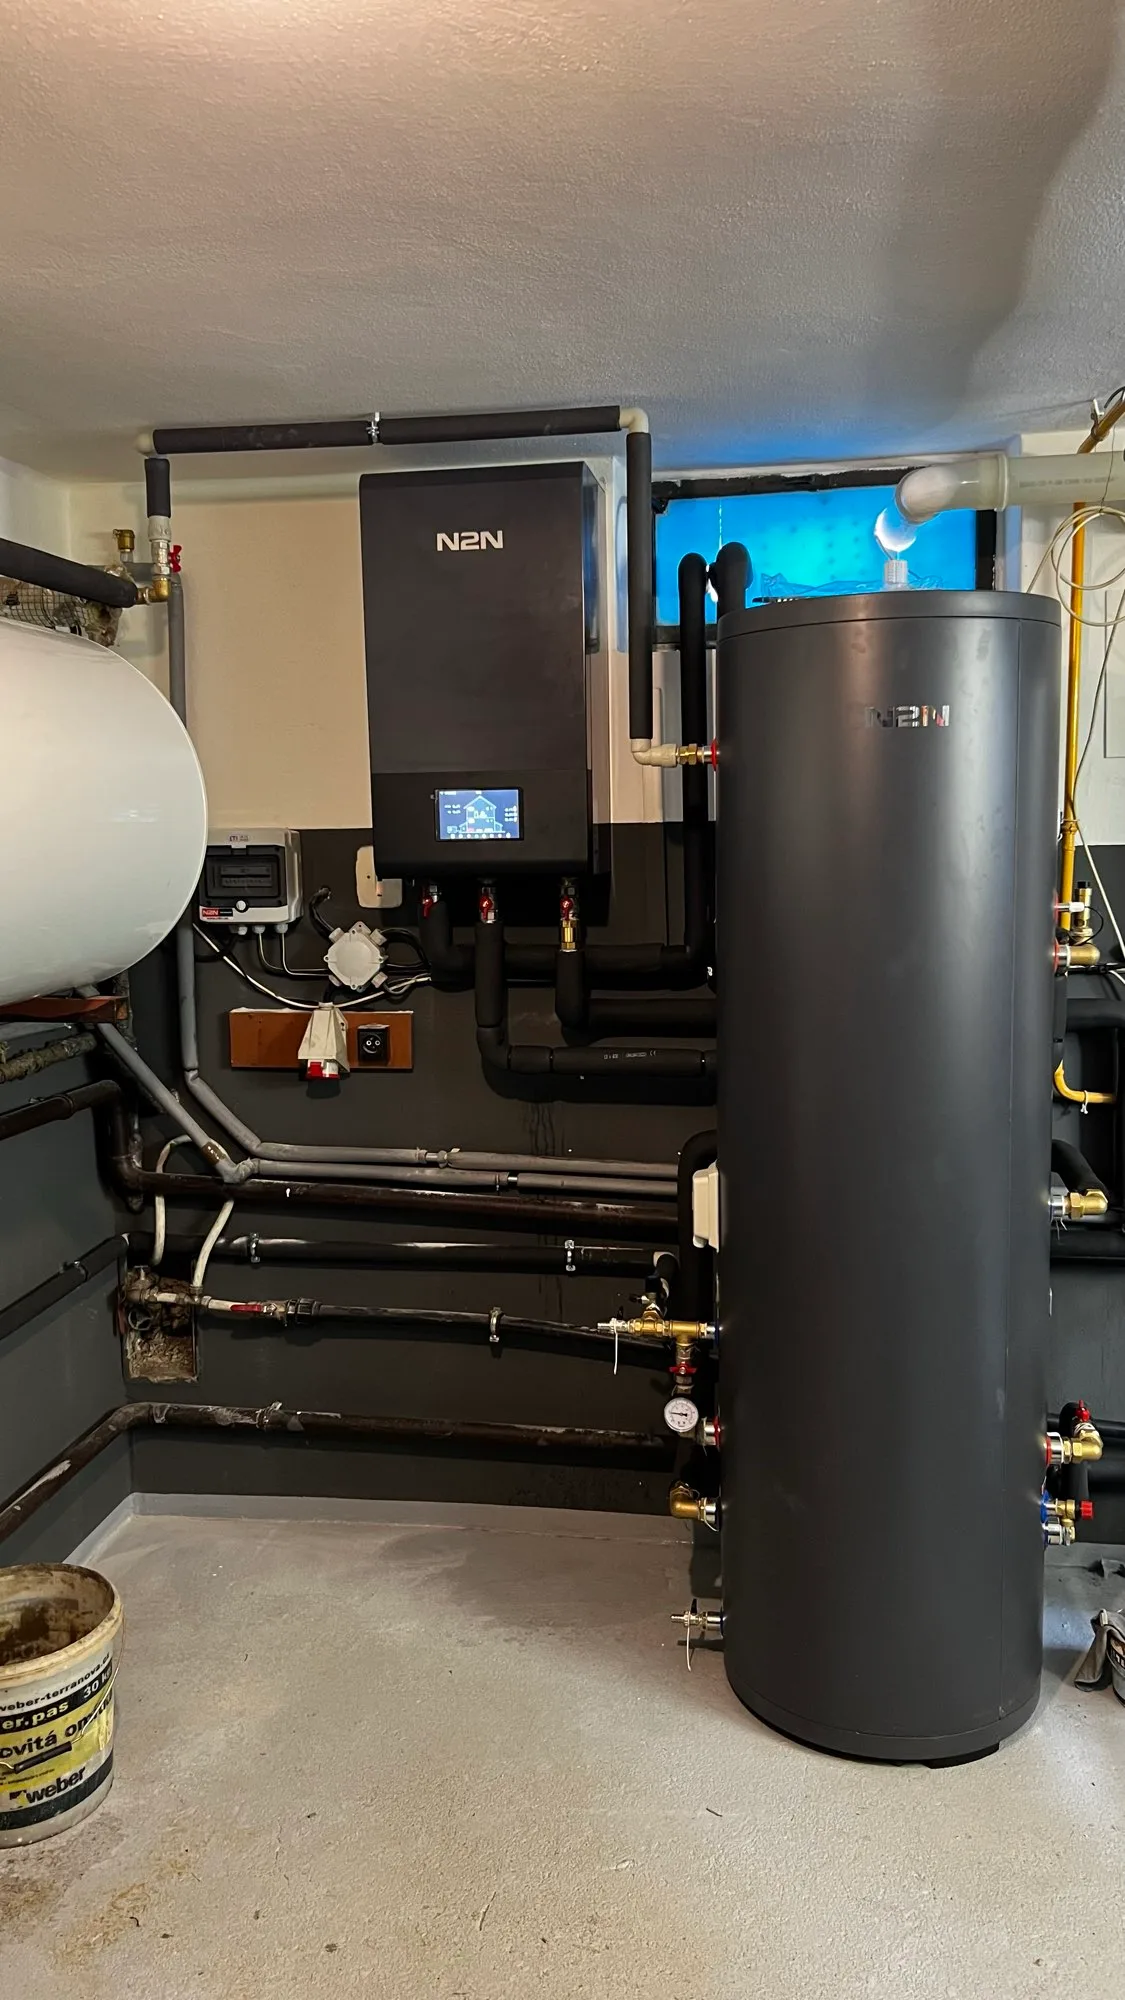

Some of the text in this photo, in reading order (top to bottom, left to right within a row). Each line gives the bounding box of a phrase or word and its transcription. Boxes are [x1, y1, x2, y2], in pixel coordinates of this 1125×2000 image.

[436, 530, 504, 552] N2N
[865, 704, 950, 728] N2N
[2, 1700, 69, 1730] er.pas
[83, 1680, 100, 1699] 30
[26, 1766, 86, 1804] weber
